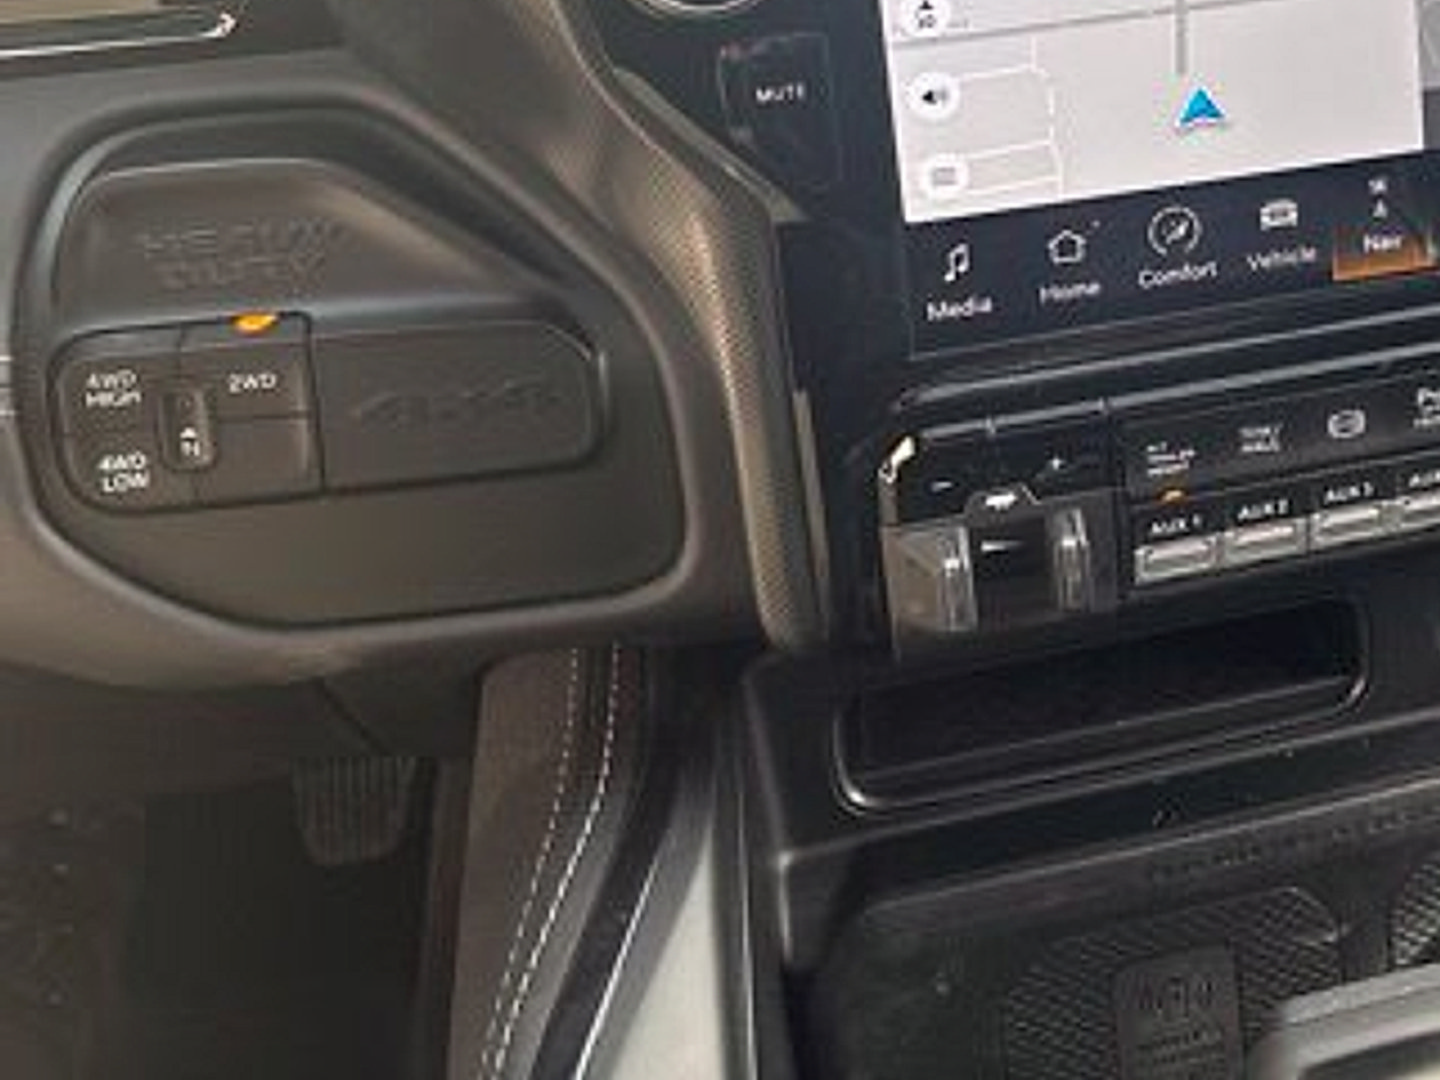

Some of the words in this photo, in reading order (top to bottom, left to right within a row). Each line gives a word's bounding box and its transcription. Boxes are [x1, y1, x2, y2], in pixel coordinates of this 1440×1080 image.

[756, 82, 805, 102] MUTE
[1363, 230, 1403, 253] Nav
[1246, 247, 1318, 272] Vehicle
[1138, 260, 1218, 290] Comfort
[1039, 281, 1102, 303] Home
[927, 297, 993, 322] Media
[86, 370, 138, 389] 4WD
[229, 373, 278, 393] 2WD
[85, 391, 142, 407] HIGH
[99, 452, 148, 471] 4WD
[103, 471, 150, 493] LOW
[1409, 470, 1440, 488] AUX
[1324, 485, 1361, 505] AUX
[1238, 503, 1273, 522] AUX
[1152, 518, 1189, 534] AUX
